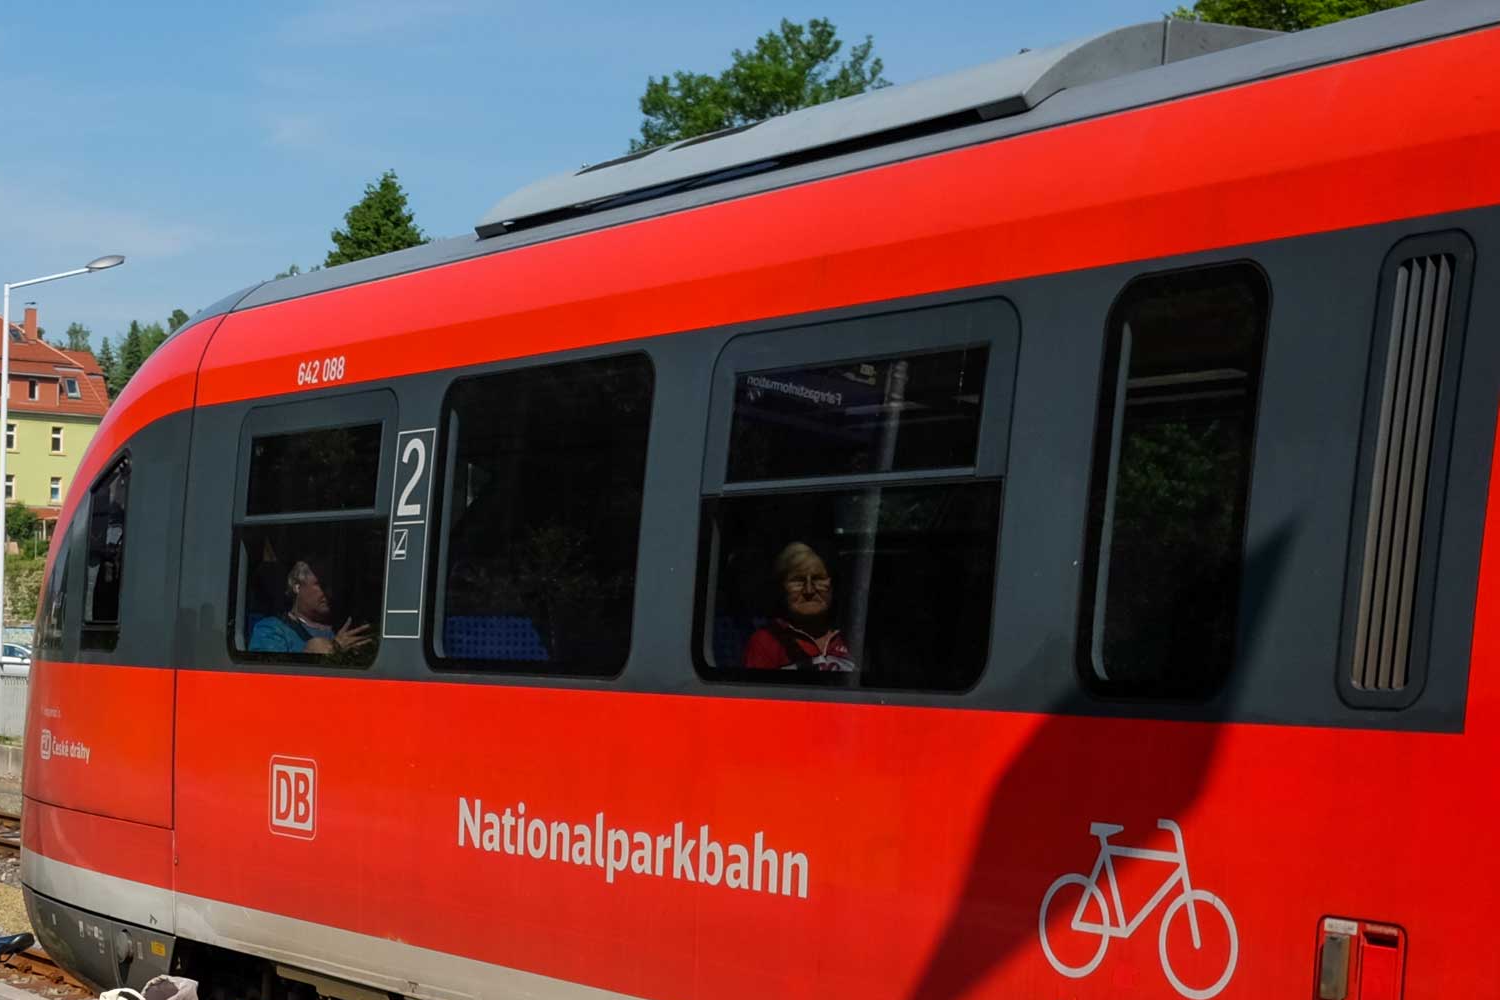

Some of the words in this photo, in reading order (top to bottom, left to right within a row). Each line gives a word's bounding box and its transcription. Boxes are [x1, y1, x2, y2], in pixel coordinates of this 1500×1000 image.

[297, 360, 320, 386] 642
[323, 355, 346, 382] 088
[397, 438, 426, 517] 2
[275, 769, 311, 824] DB
[457, 796, 809, 899] Nationalparkbahn
